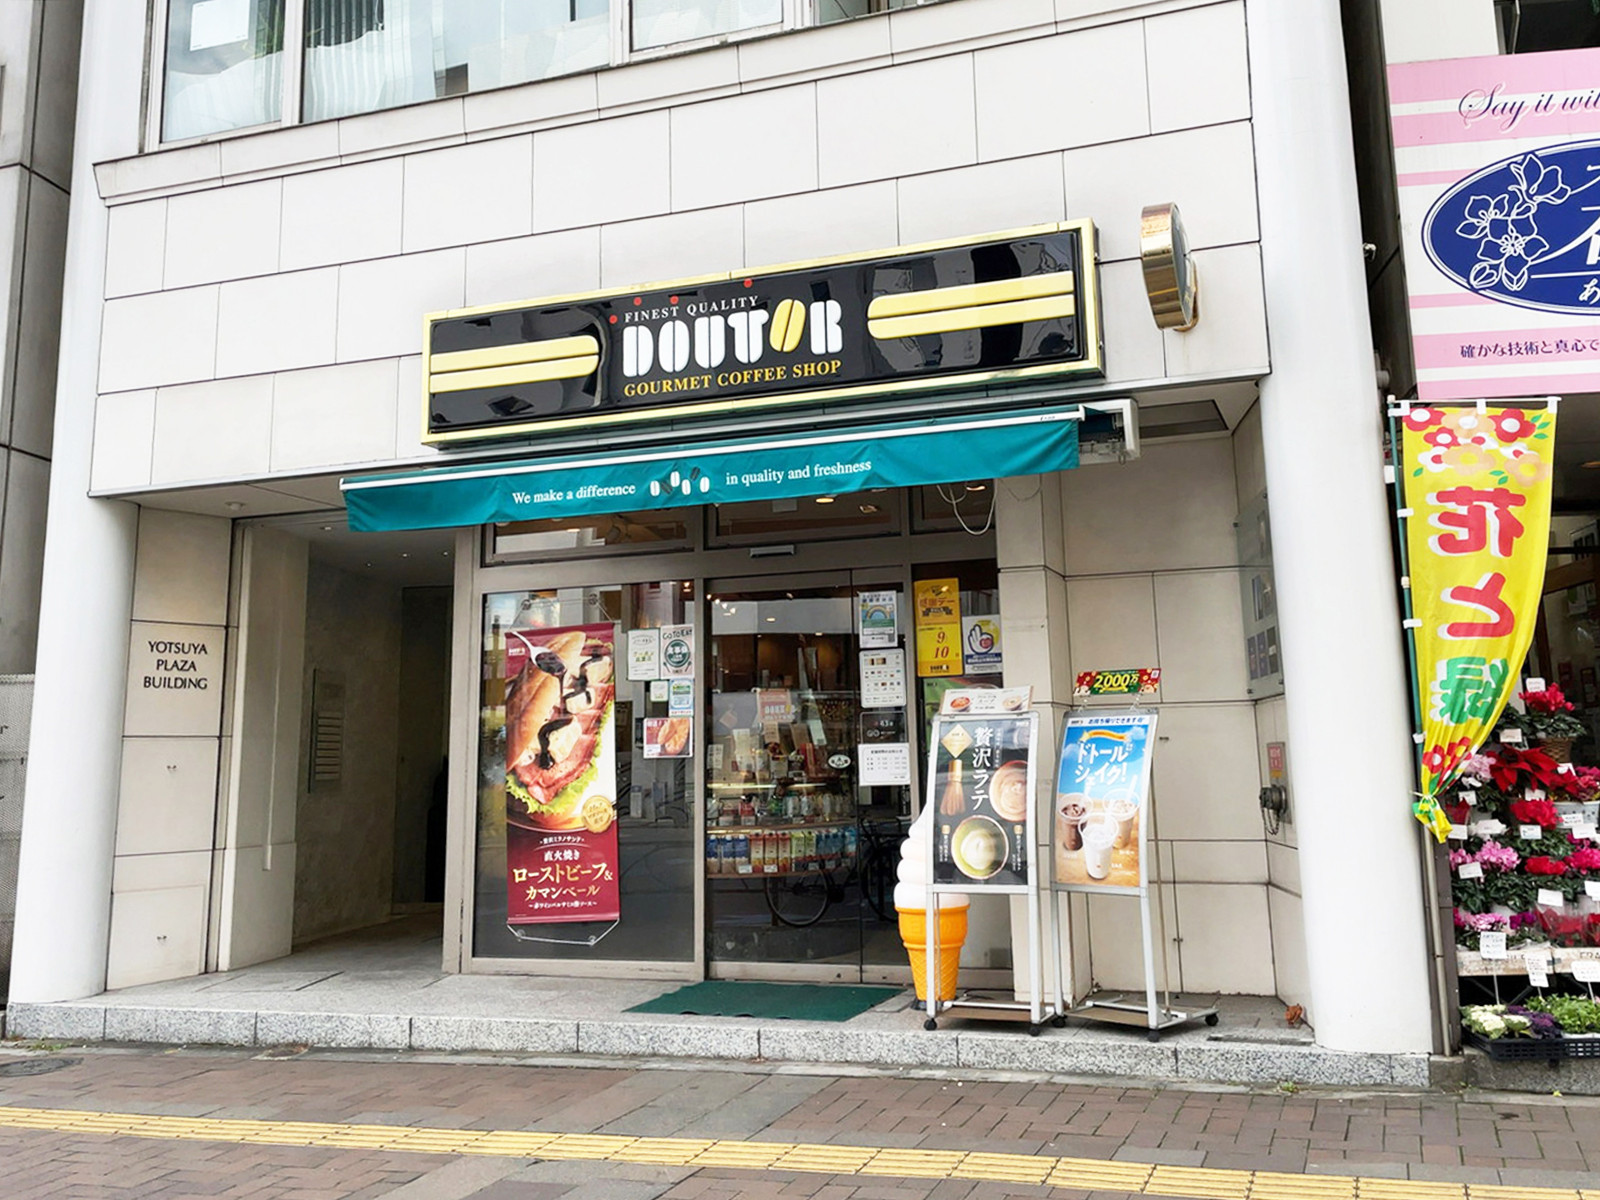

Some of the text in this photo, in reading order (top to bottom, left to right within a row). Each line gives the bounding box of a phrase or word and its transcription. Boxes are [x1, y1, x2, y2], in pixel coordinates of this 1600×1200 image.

[1459, 83, 1525, 131] Say
[1535, 94, 1554, 112] it
[624, 295, 759, 323] FINEST QUALITY
[622, 298, 843, 378] DOUTOR
[624, 359, 842, 397] GOURMET COFFEE SHOP
[726, 460, 872, 487] in quality and freshness
[512, 484, 636, 504] We make a difference
[148, 640, 208, 655] YOTSUYA
[937, 631, 946, 644] 9
[934, 646, 950, 658] 10
[156, 658, 197, 672] PLAZA
[143, 675, 208, 690] BUILDING
[1078, 743, 1129, 765] ドトール
[971, 727, 993, 811] 贅沢ラテ
[525, 885, 601, 901] カマンベール
